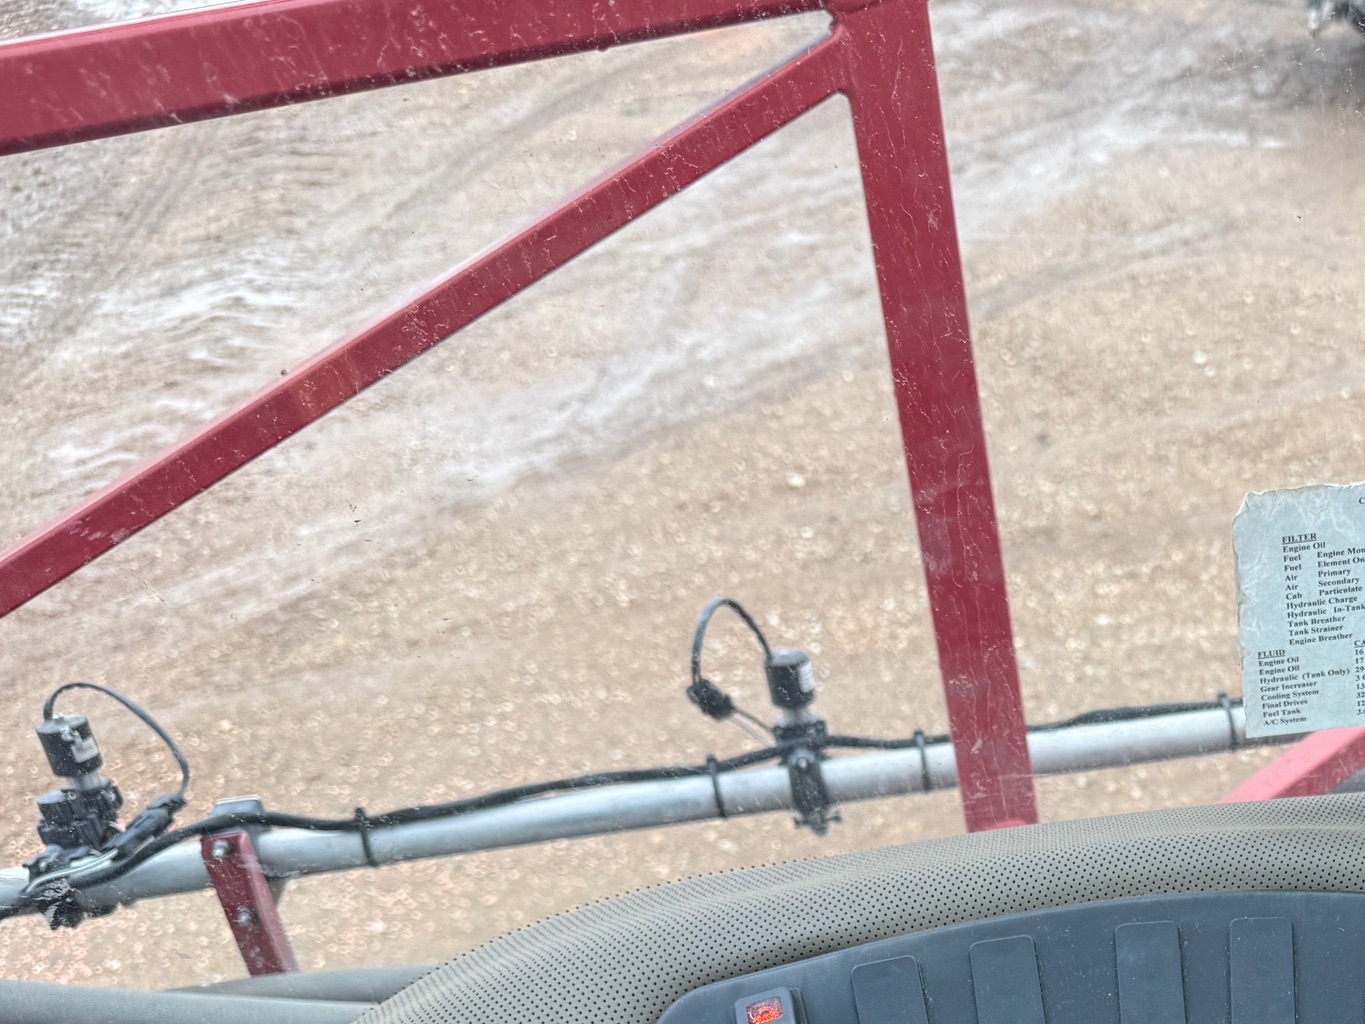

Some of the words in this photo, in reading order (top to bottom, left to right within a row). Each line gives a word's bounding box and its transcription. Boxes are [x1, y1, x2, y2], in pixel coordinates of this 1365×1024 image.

[1282, 533, 1317, 544] FILTER
[1283, 545, 1310, 553] Engine
[1317, 550, 1344, 558] Engine
[1318, 558, 1350, 567] Element
[1318, 569, 1351, 577] Primary
[1318, 577, 1359, 587] Secondary
[1319, 586, 1362, 596] Particulate
[1287, 600, 1326, 610] Hydraulic
[1329, 596, 1358, 604] Charge
[1288, 609, 1326, 619] Hydraulic
[1334, 604, 1365, 613] In-Tank
[1288, 619, 1308, 627] Tank
[1311, 616, 1346, 625] Breather
[1311, 625, 1343, 633] Strainer
[1319, 633, 1353, 642] Breather
[1258, 649, 1285, 659] FLUID
[1259, 658, 1285, 667] Engine
[1260, 667, 1285, 675] Engine
[1260, 675, 1298, 684] Hydraulic
[1302, 671, 1326, 680] (Tank
[1282, 681, 1317, 690] Increaser
[1261, 692, 1290, 701] Cooling
[1292, 690, 1319, 698] System
